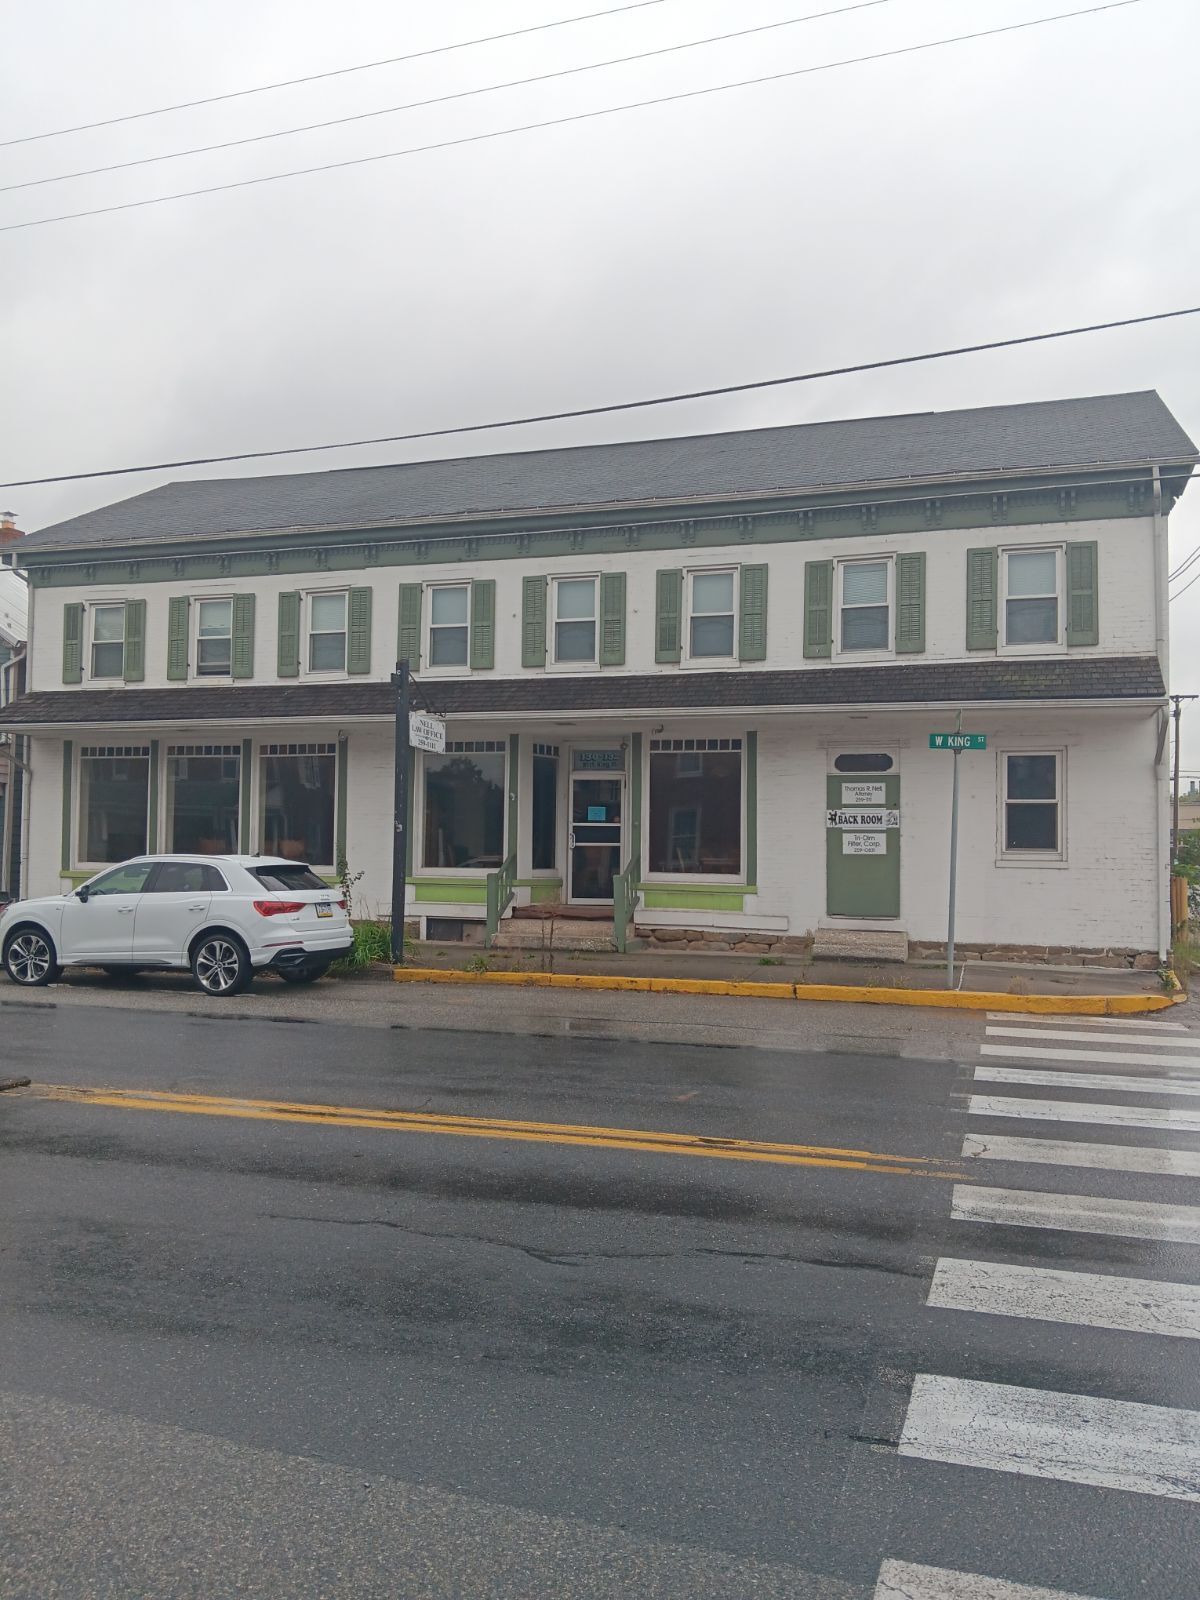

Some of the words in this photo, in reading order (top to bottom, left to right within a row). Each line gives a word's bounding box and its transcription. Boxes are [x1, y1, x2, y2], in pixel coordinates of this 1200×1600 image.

[419, 719, 434, 730] NELL
[411, 723, 422, 733] LAW
[423, 728, 443, 740] OFFICE
[935, 736, 943, 746] W
[947, 736, 971, 747] KING
[838, 815, 859, 825] BACK
[861, 815, 883, 825] ROOM
